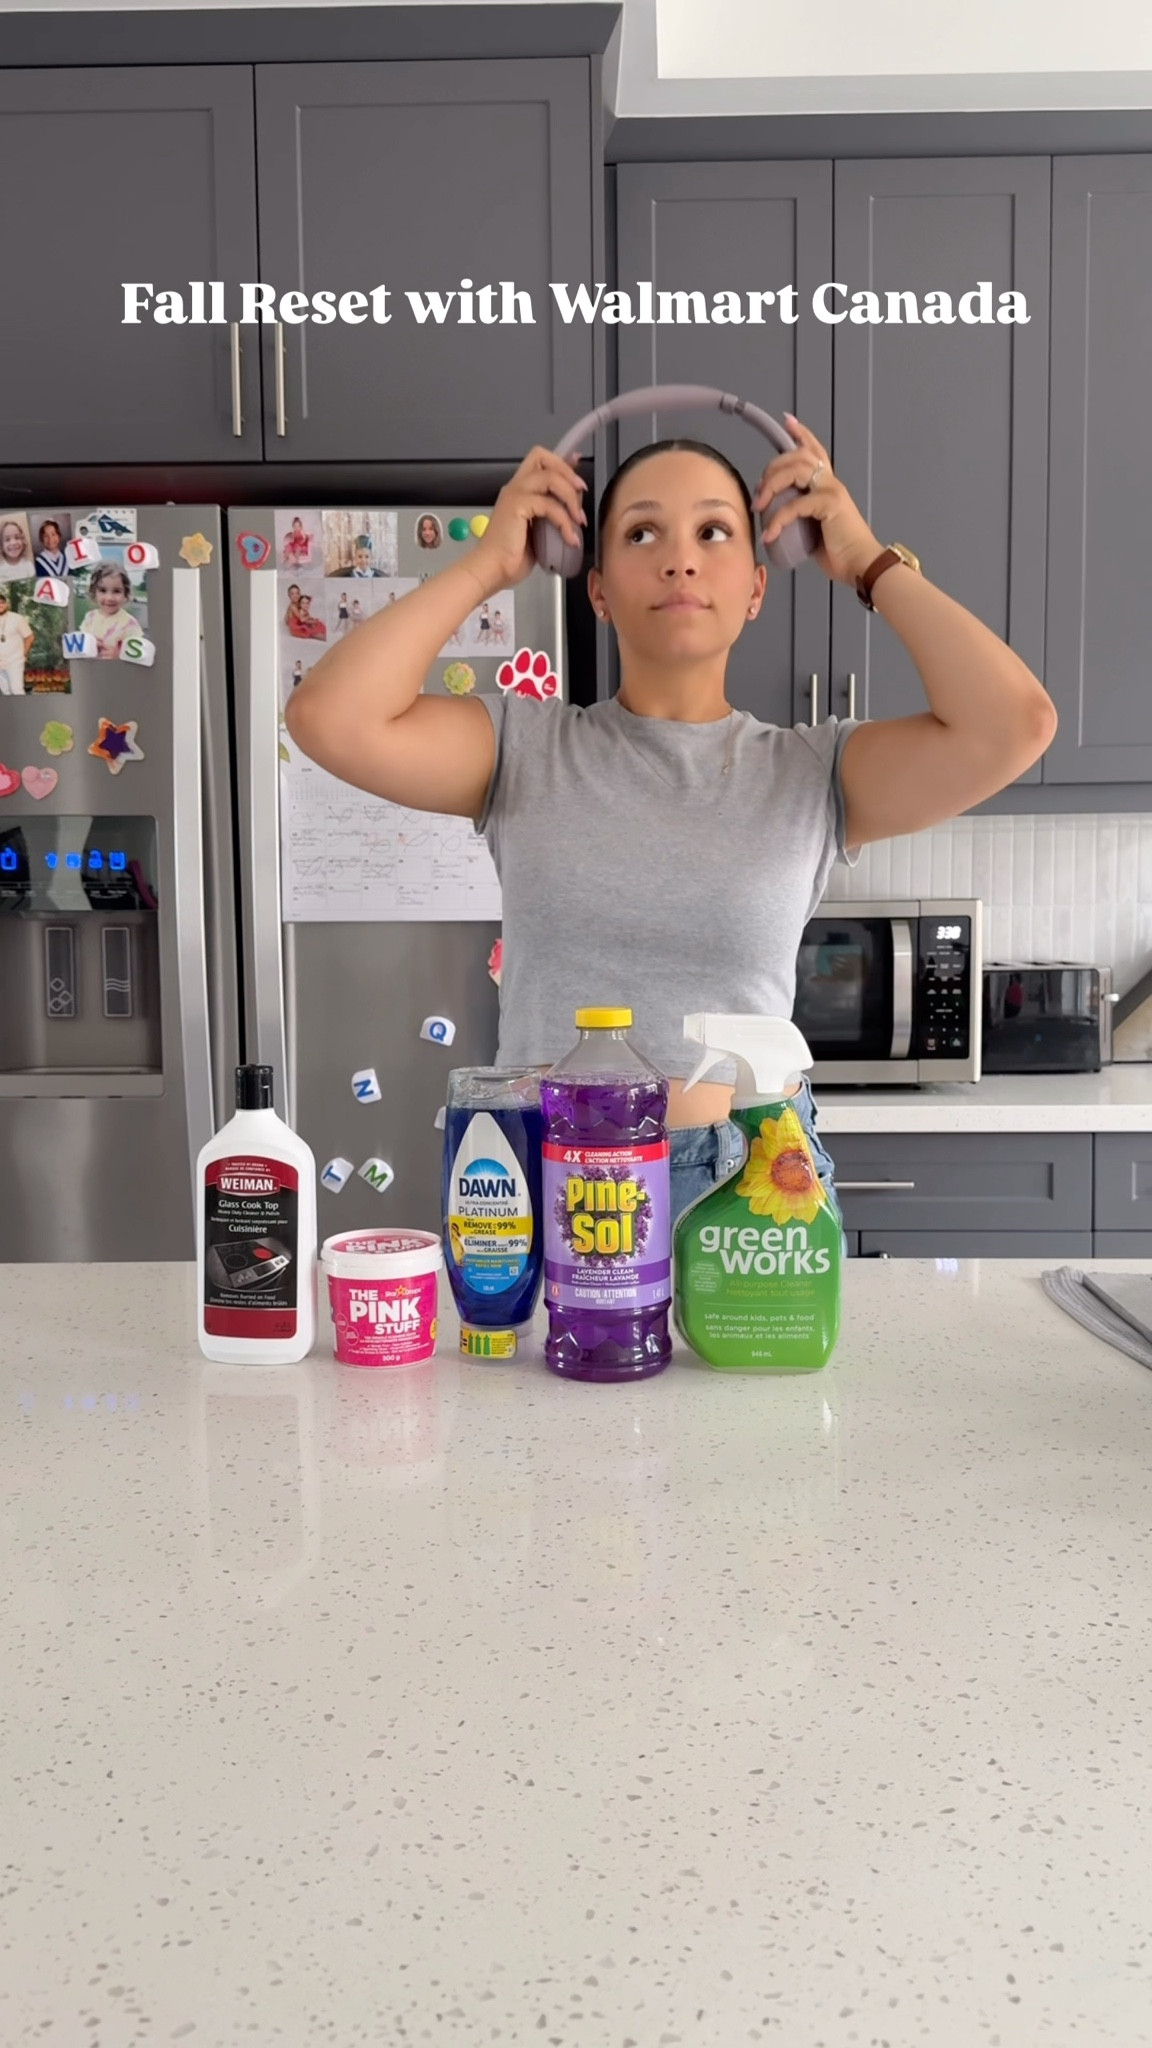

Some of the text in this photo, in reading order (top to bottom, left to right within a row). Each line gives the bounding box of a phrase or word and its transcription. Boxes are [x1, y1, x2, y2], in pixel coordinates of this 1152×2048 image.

[69, 538, 87, 561] I
[127, 544, 146, 564] O
[37, 580, 55, 600] A
[63, 633, 85, 653] W
[125, 638, 143, 659] S
[429, 1021, 447, 1042] Q
[563, 1150, 582, 1163] 4X
[322, 1165, 341, 1182] T
[220, 1177, 274, 1191] WEIMAN
[459, 1178, 516, 1197] DAWN
[566, 1177, 646, 1212] Pine-
[218, 1200, 279, 1210] Glass Cook Top
[458, 1206, 518, 1217] PLATINUM
[228, 1224, 267, 1233] Cuisinière
[463, 1221, 492, 1229] REMOVE
[497, 1221, 516, 1230] 99%
[571, 1213, 633, 1254] Sol
[464, 1238, 497, 1247] ÉLIMINER
[508, 1239, 527, 1248] 99%
[699, 1225, 807, 1253] green
[348, 1289, 379, 1300] THE
[575, 1287, 600, 1297] CAUTION
[349, 1296, 421, 1323] PINK
[704, 1313, 720, 1321] safe
[770, 1315, 787, 1323] pets
[375, 1319, 420, 1335] STUFF
[724, 1324, 750, 1333] danger
[753, 1325, 770, 1333] pour
